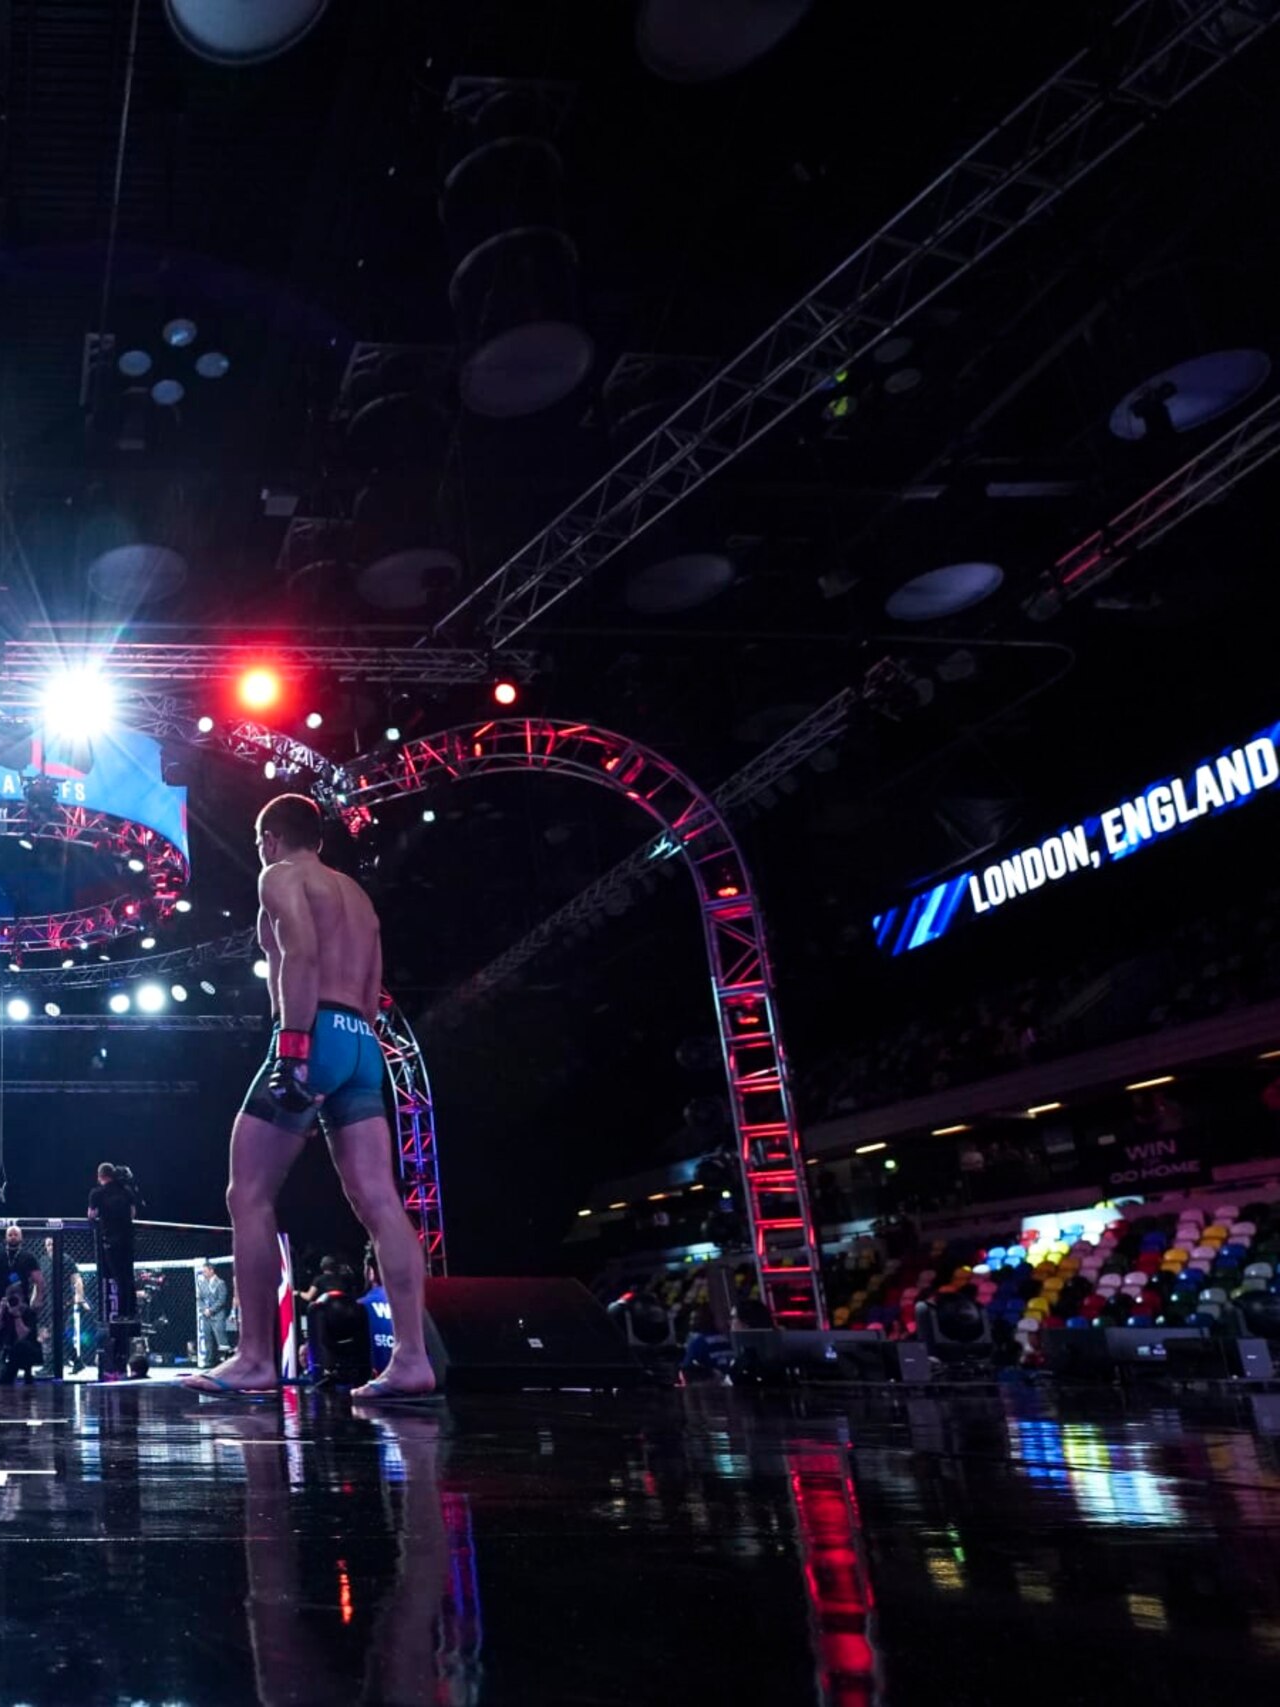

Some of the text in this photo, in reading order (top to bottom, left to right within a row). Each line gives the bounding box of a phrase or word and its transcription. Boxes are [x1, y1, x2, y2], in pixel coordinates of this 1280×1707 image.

[968, 737, 1280, 915] LONDON, ENGLAND
[1123, 1138, 1177, 1162] WIN
[1140, 1159, 1201, 1180] HOME
